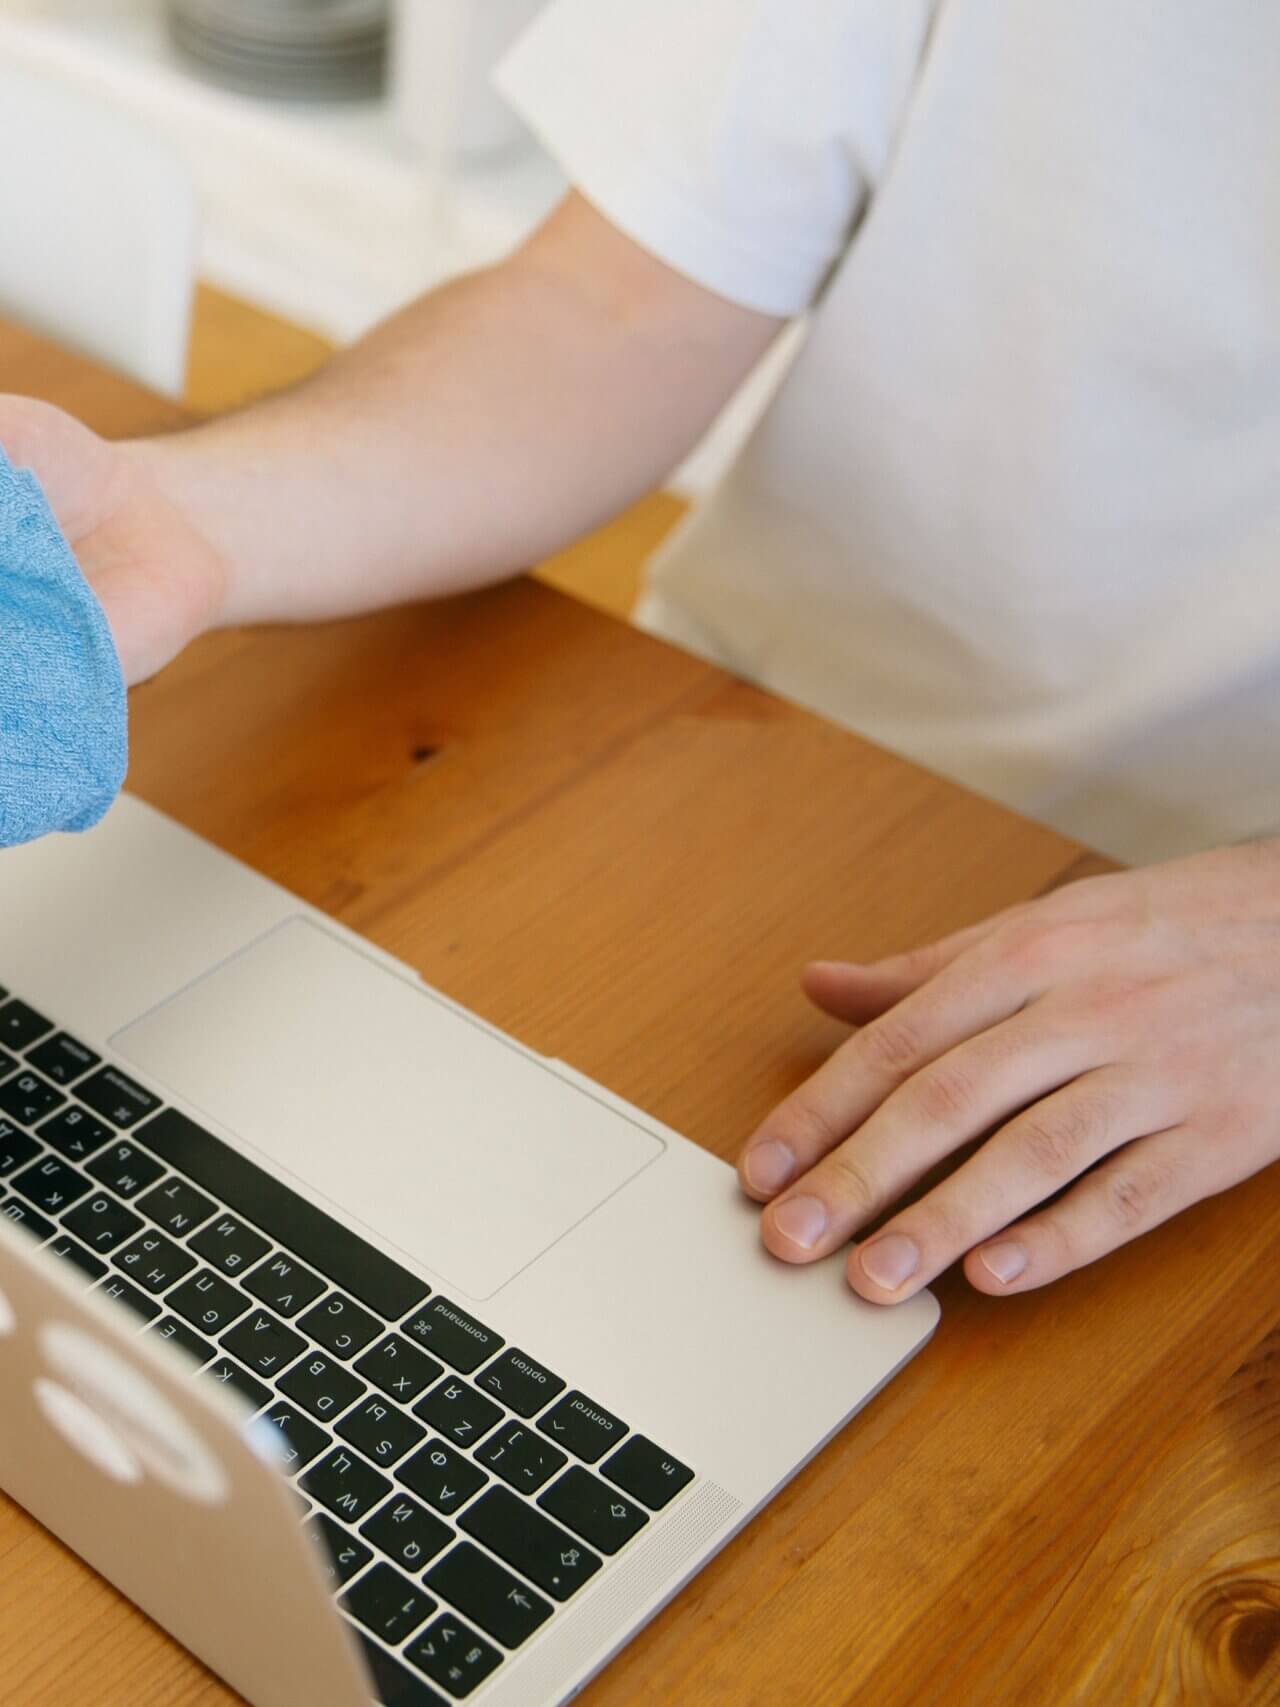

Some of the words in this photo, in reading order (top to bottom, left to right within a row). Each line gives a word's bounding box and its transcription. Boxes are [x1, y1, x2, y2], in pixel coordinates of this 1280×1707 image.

[1, 1155, 14, 1168] L
[117, 1176, 136, 1190] M
[46, 1192, 63, 1205] K
[170, 1214, 188, 1228] N
[97, 1232, 112, 1240] J
[225, 1254, 242, 1267] B
[147, 1268, 165, 1283] H
[277, 1295, 293, 1307] V
[202, 1310, 218, 1323] G
[434, 1304, 488, 1342] command
[336, 1335, 351, 1347] C
[259, 1356, 276, 1366] F
[511, 1357, 546, 1383] option
[392, 1376, 411, 1392] X
[317, 1396, 334, 1410] D
[570, 1400, 613, 1430] control
[454, 1420, 472, 1436] Z
[376, 1441, 392, 1454] S
[430, 1452, 447, 1466] Ф
[661, 1461, 676, 1477] fn
[440, 1485, 456, 1500] A
[336, 1493, 358, 1512] W
[339, 1547, 356, 1563] 2
[403, 1541, 420, 1559] Q
[402, 1598, 415, 1612] 1
